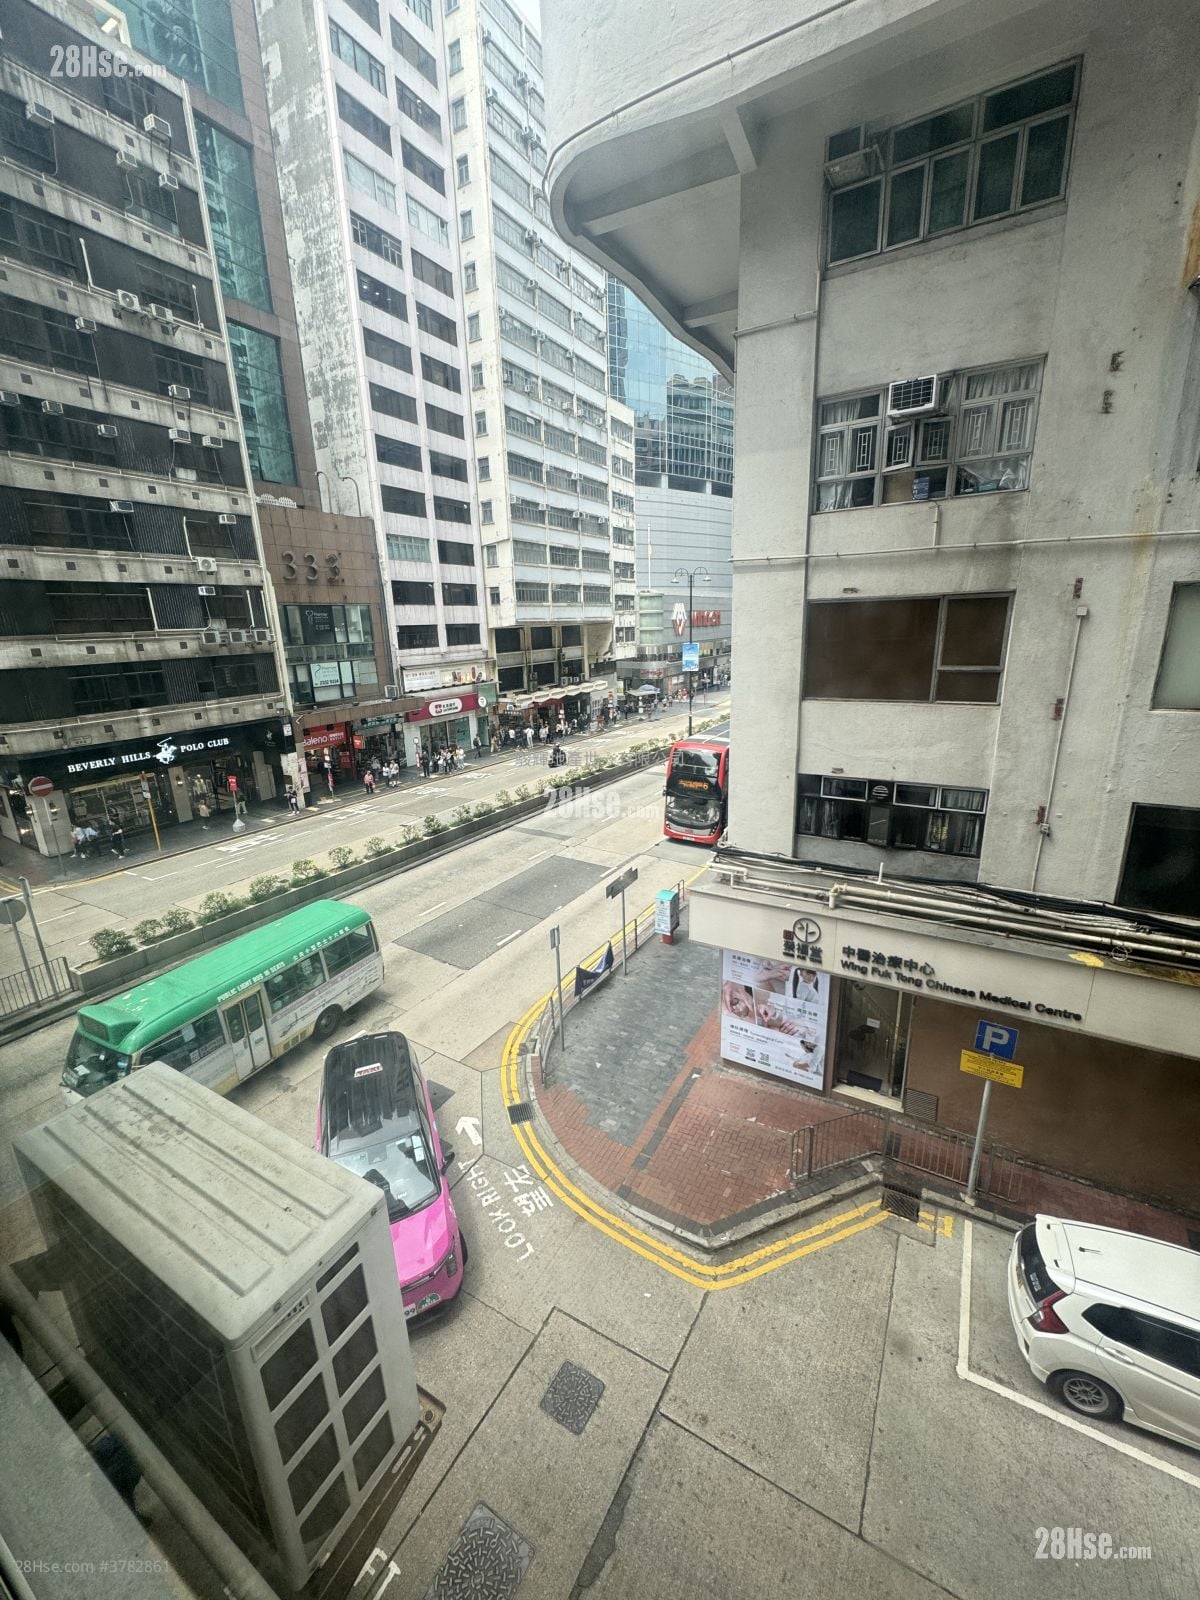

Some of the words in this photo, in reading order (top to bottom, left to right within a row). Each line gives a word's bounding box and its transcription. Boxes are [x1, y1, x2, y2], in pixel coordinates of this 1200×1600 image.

[282, 551, 342, 583] 333
[67, 757, 116, 773] BEVERLY
[121, 751, 152, 764] HILLS
[180, 743, 204, 753] POLO
[207, 737, 230, 749] CLUB
[842, 945, 935, 977] 中醫治療中心
[217, 987, 238, 1002] PUBLIC
[236, 979, 252, 992] LIGHT
[252, 973, 264, 983] BUS
[841, 959, 868, 975] Wing
[871, 967, 891, 980] Fuk
[894, 972, 923, 988] Tong
[926, 979, 976, 998] Chinese
[979, 990, 1031, 1011] Medical
[1035, 1003, 1082, 1021] Centre
[982, 1025, 1010, 1051] P
[458, 1158, 501, 1208] RIGHT
[504, 1164, 554, 1217] 望右
[488, 1208, 535, 1263] LOOK
